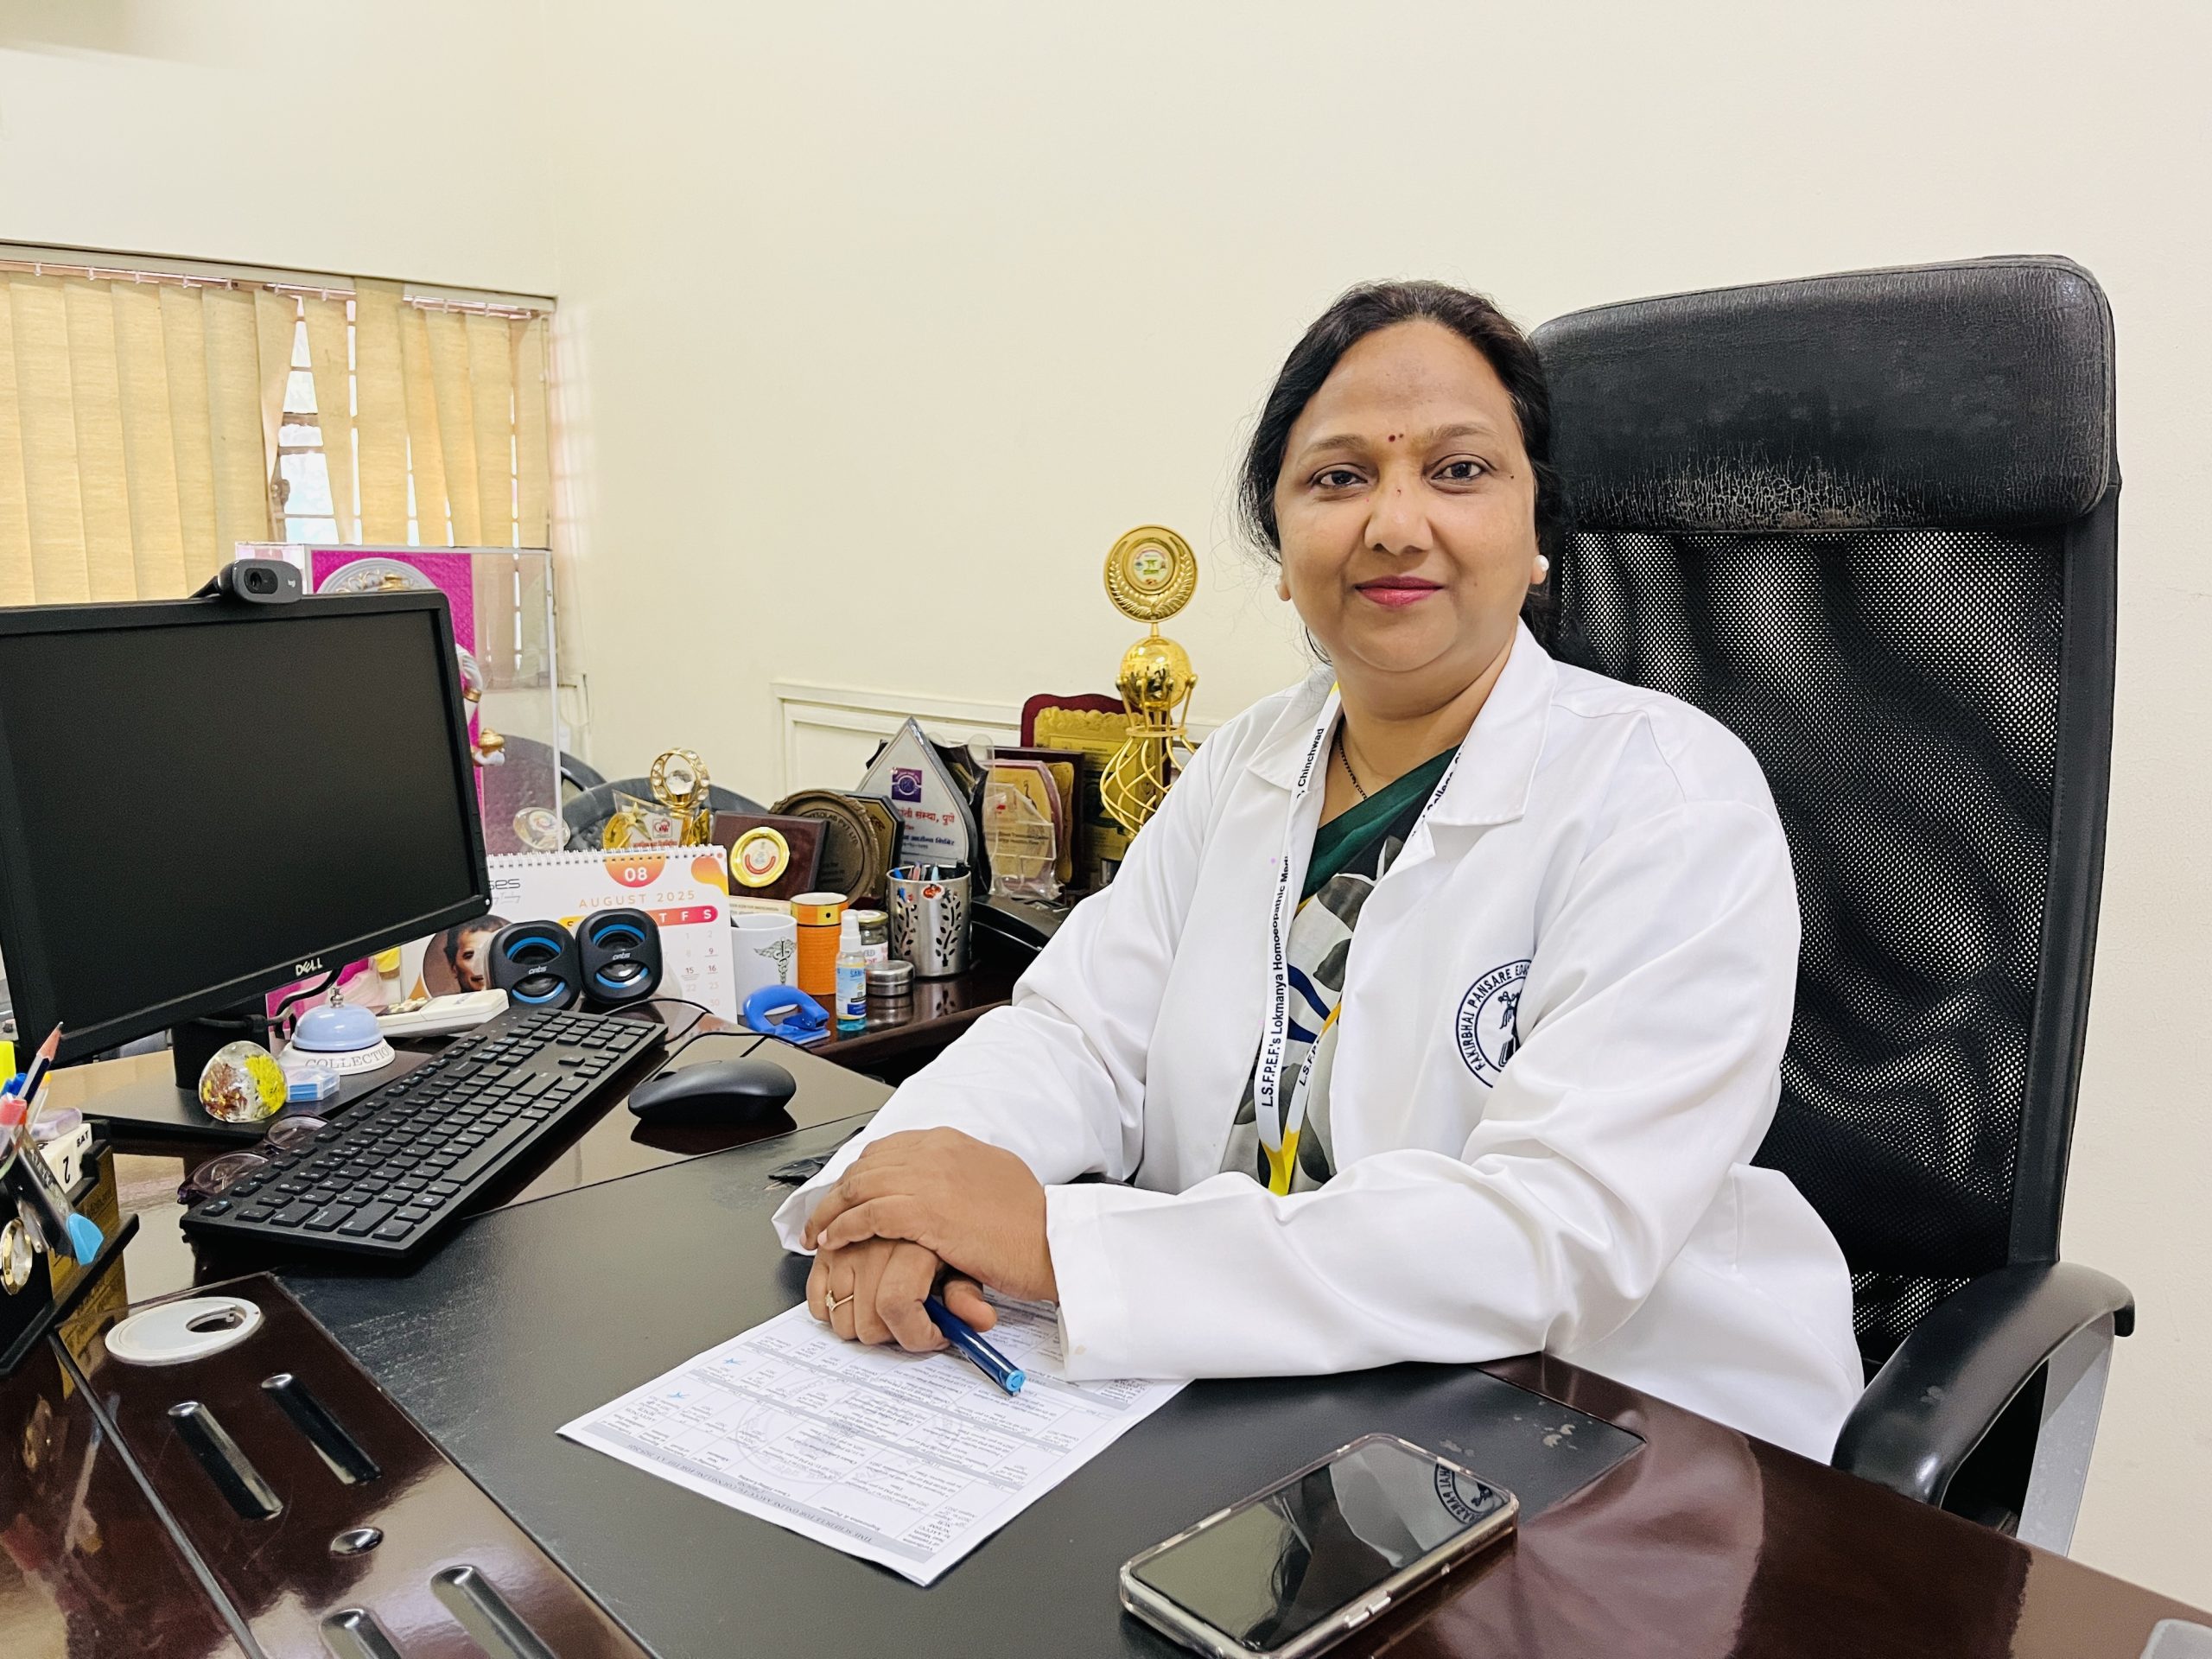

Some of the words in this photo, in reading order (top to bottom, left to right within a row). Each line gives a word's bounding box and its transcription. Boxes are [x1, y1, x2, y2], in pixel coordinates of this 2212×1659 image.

[1298, 728, 1325, 788] Chinchwad
[624, 868, 648, 882] 08
[579, 893, 646, 908] AUGUST
[657, 890, 696, 903] 2025
[681, 911, 690, 921] F
[702, 909, 712, 919] S
[296, 957, 324, 976] DELL
[1467, 968, 1513, 1009] PANSARE
[1269, 974, 1287, 1035] Lokmanya
[1459, 1011, 1487, 1071] FAKIRBHAI
[76, 1130, 89, 1148] SAT
